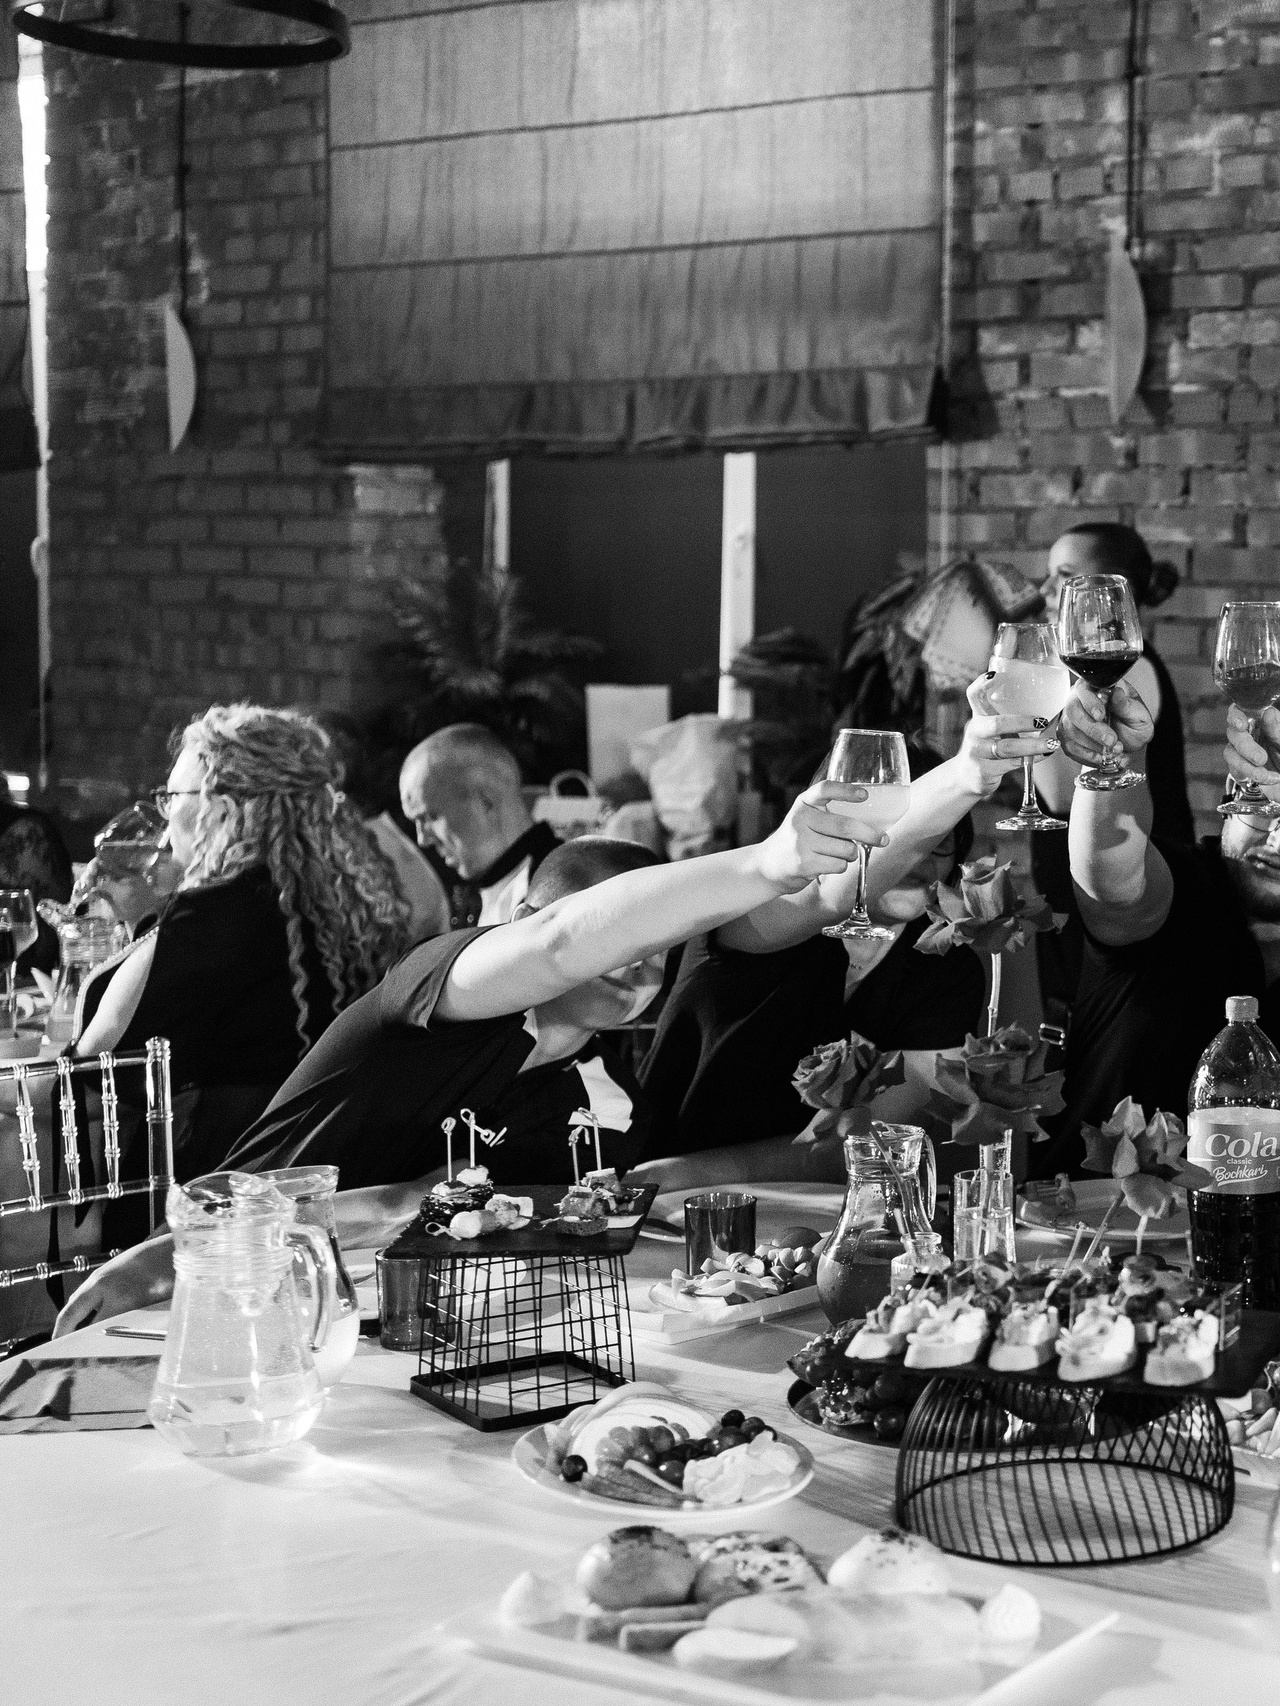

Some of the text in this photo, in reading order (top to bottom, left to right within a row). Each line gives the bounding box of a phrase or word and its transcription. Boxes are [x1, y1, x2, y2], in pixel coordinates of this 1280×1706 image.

[1205, 1132, 1278, 1158] Cola
[1226, 1157, 1253, 1165] classic
[1213, 1164, 1268, 1184] Bochkari
